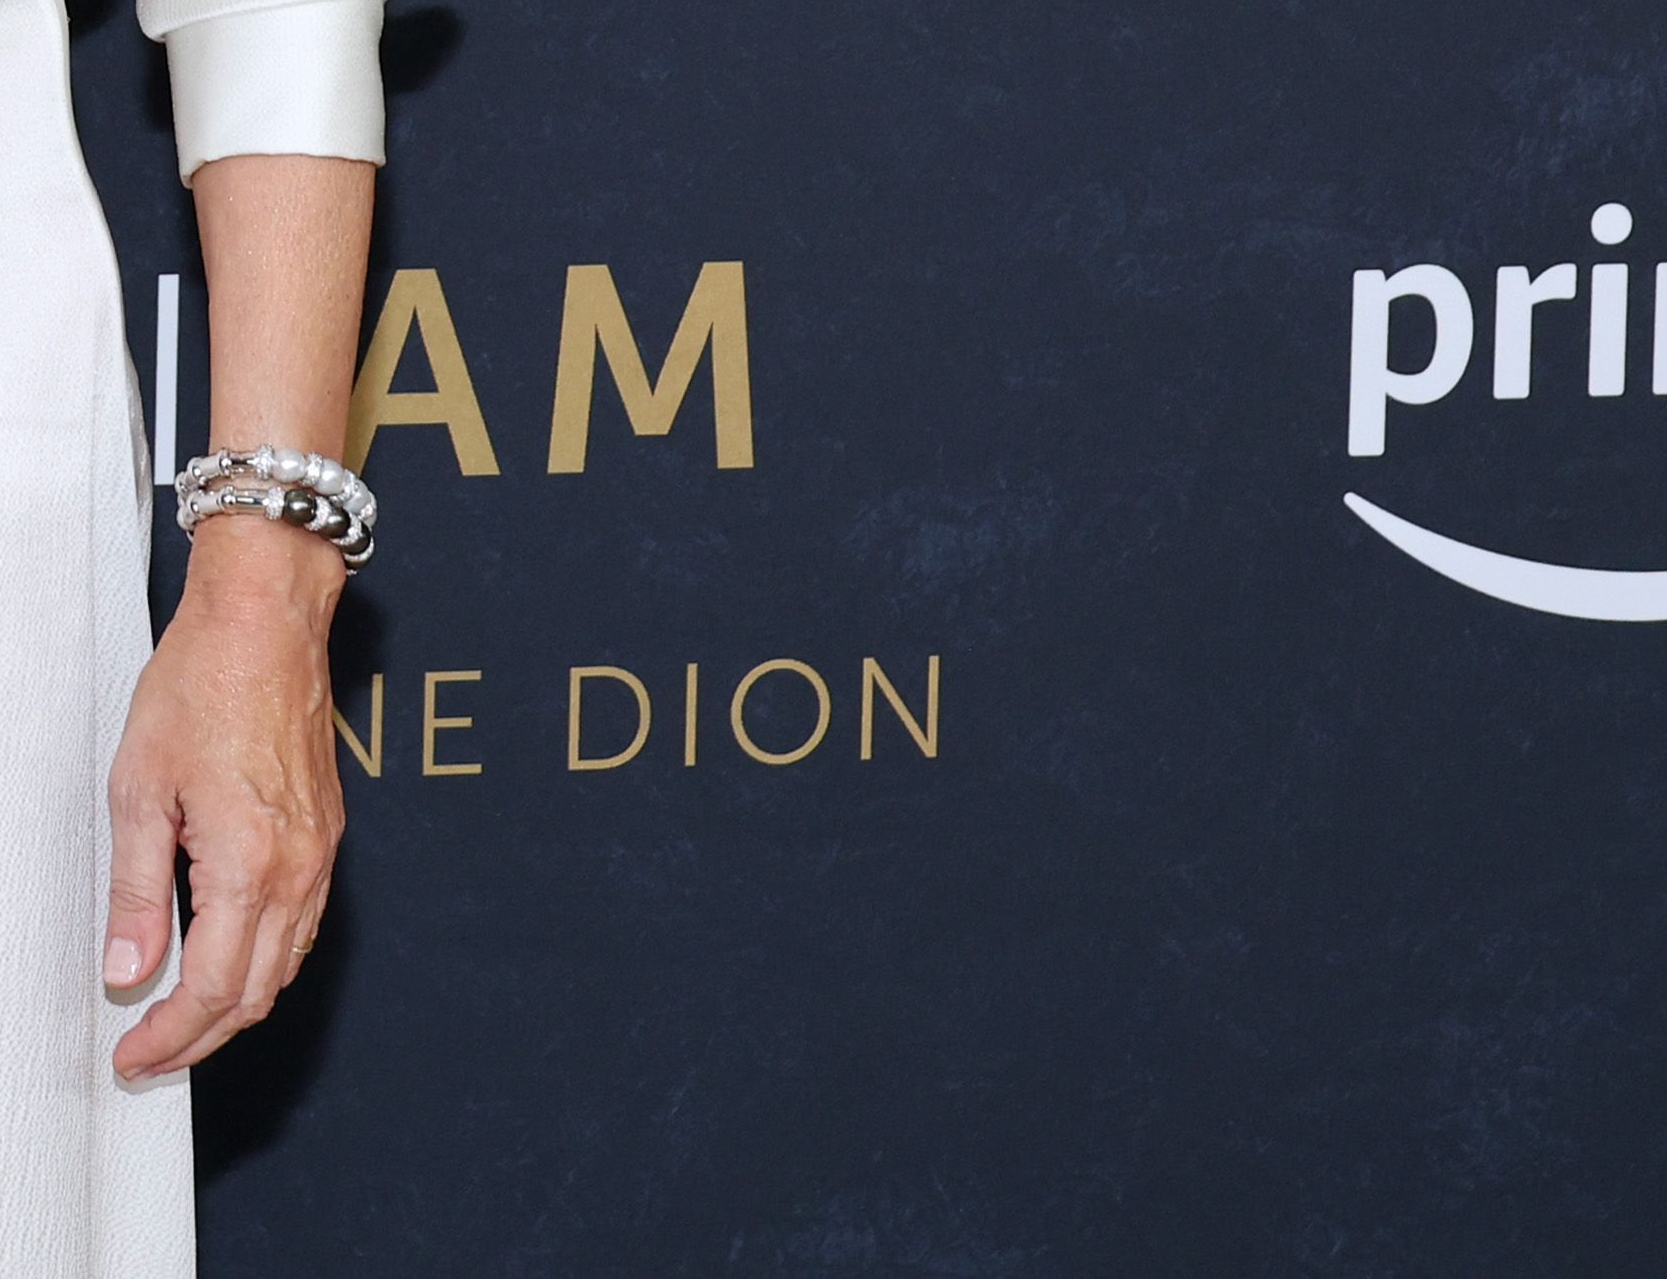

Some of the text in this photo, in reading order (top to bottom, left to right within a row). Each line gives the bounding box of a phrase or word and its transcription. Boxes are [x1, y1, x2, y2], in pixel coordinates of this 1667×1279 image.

[341, 260, 755, 476] AM
[1347, 202, 1667, 457] pri
[567, 655, 941, 772] DION
